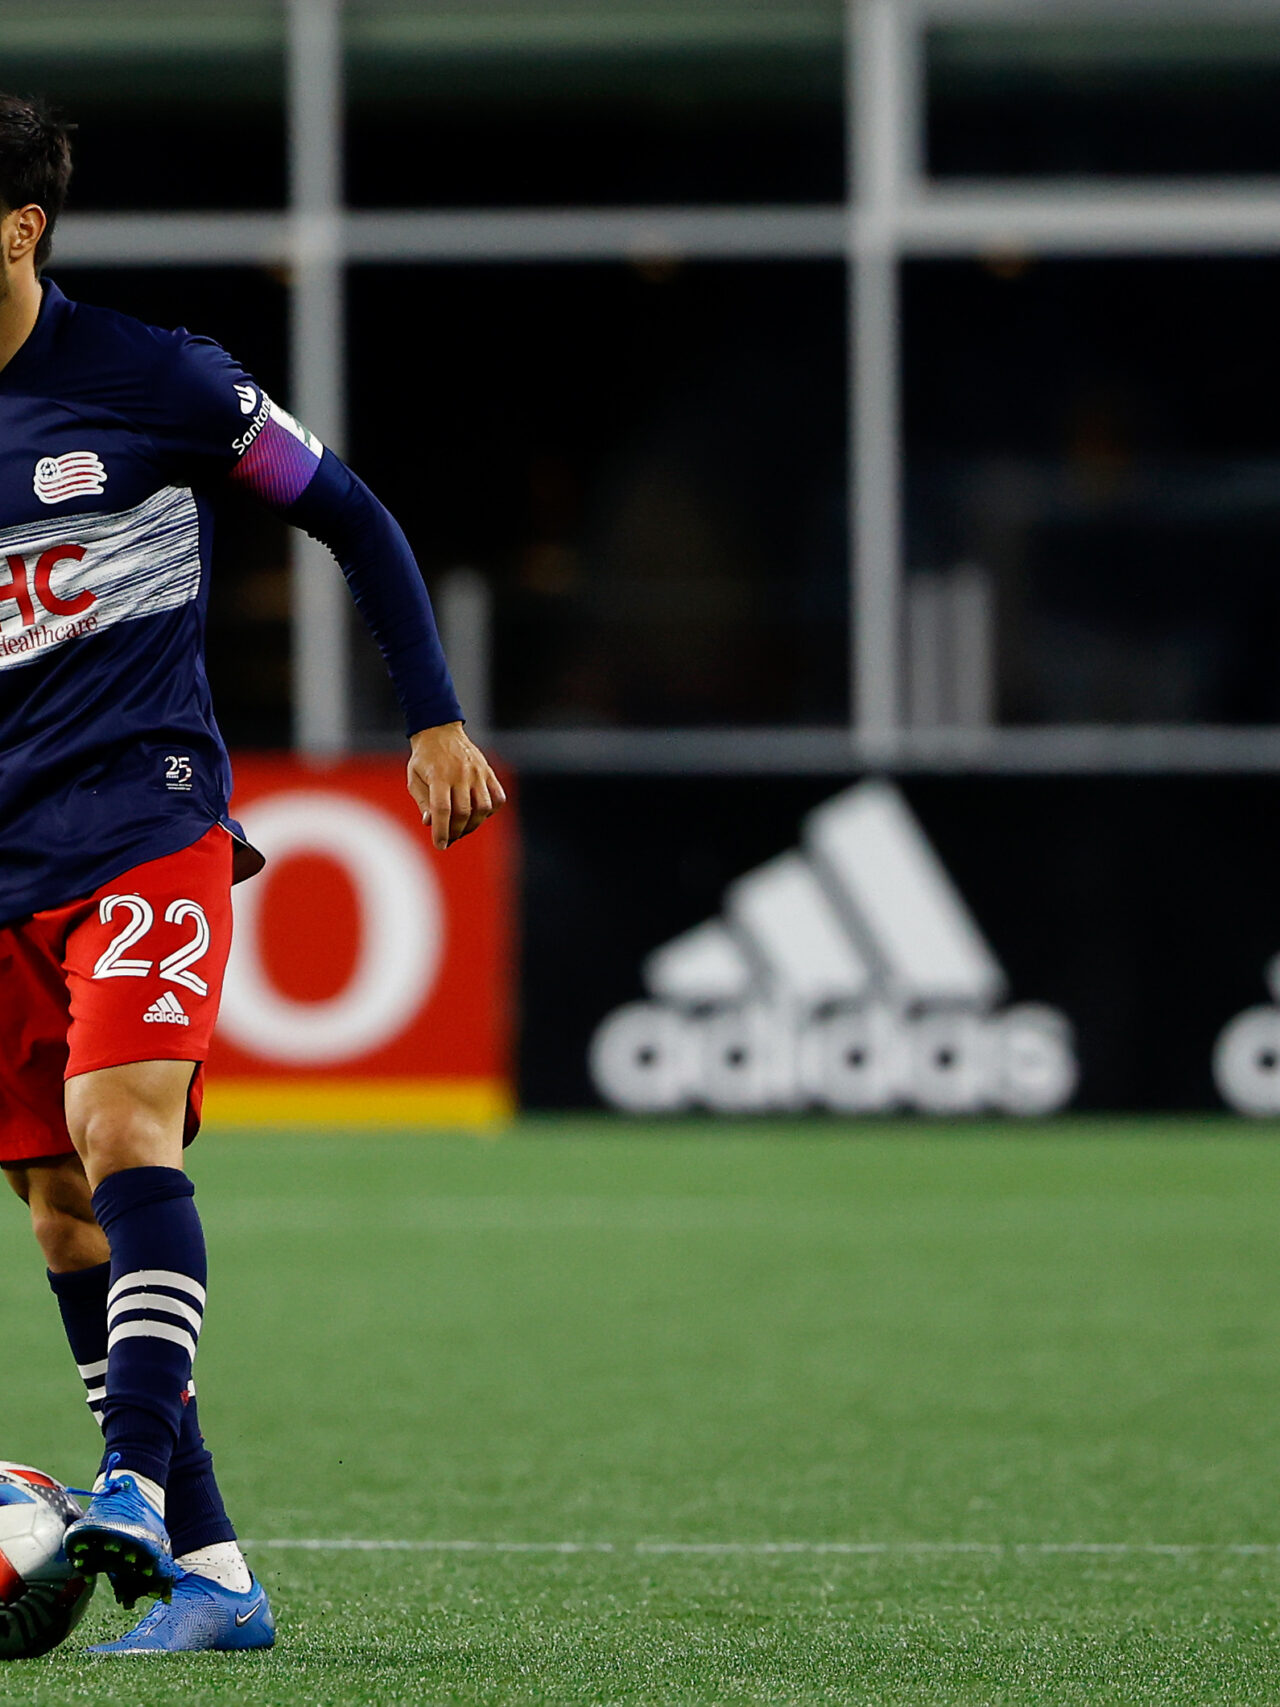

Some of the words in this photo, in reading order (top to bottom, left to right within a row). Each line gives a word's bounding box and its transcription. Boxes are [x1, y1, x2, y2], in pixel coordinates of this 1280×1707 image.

[164, 755, 192, 783] 25
[91, 892, 211, 997] 22
[142, 1010, 190, 1026] adidas
[588, 995, 1078, 1116] adidas
